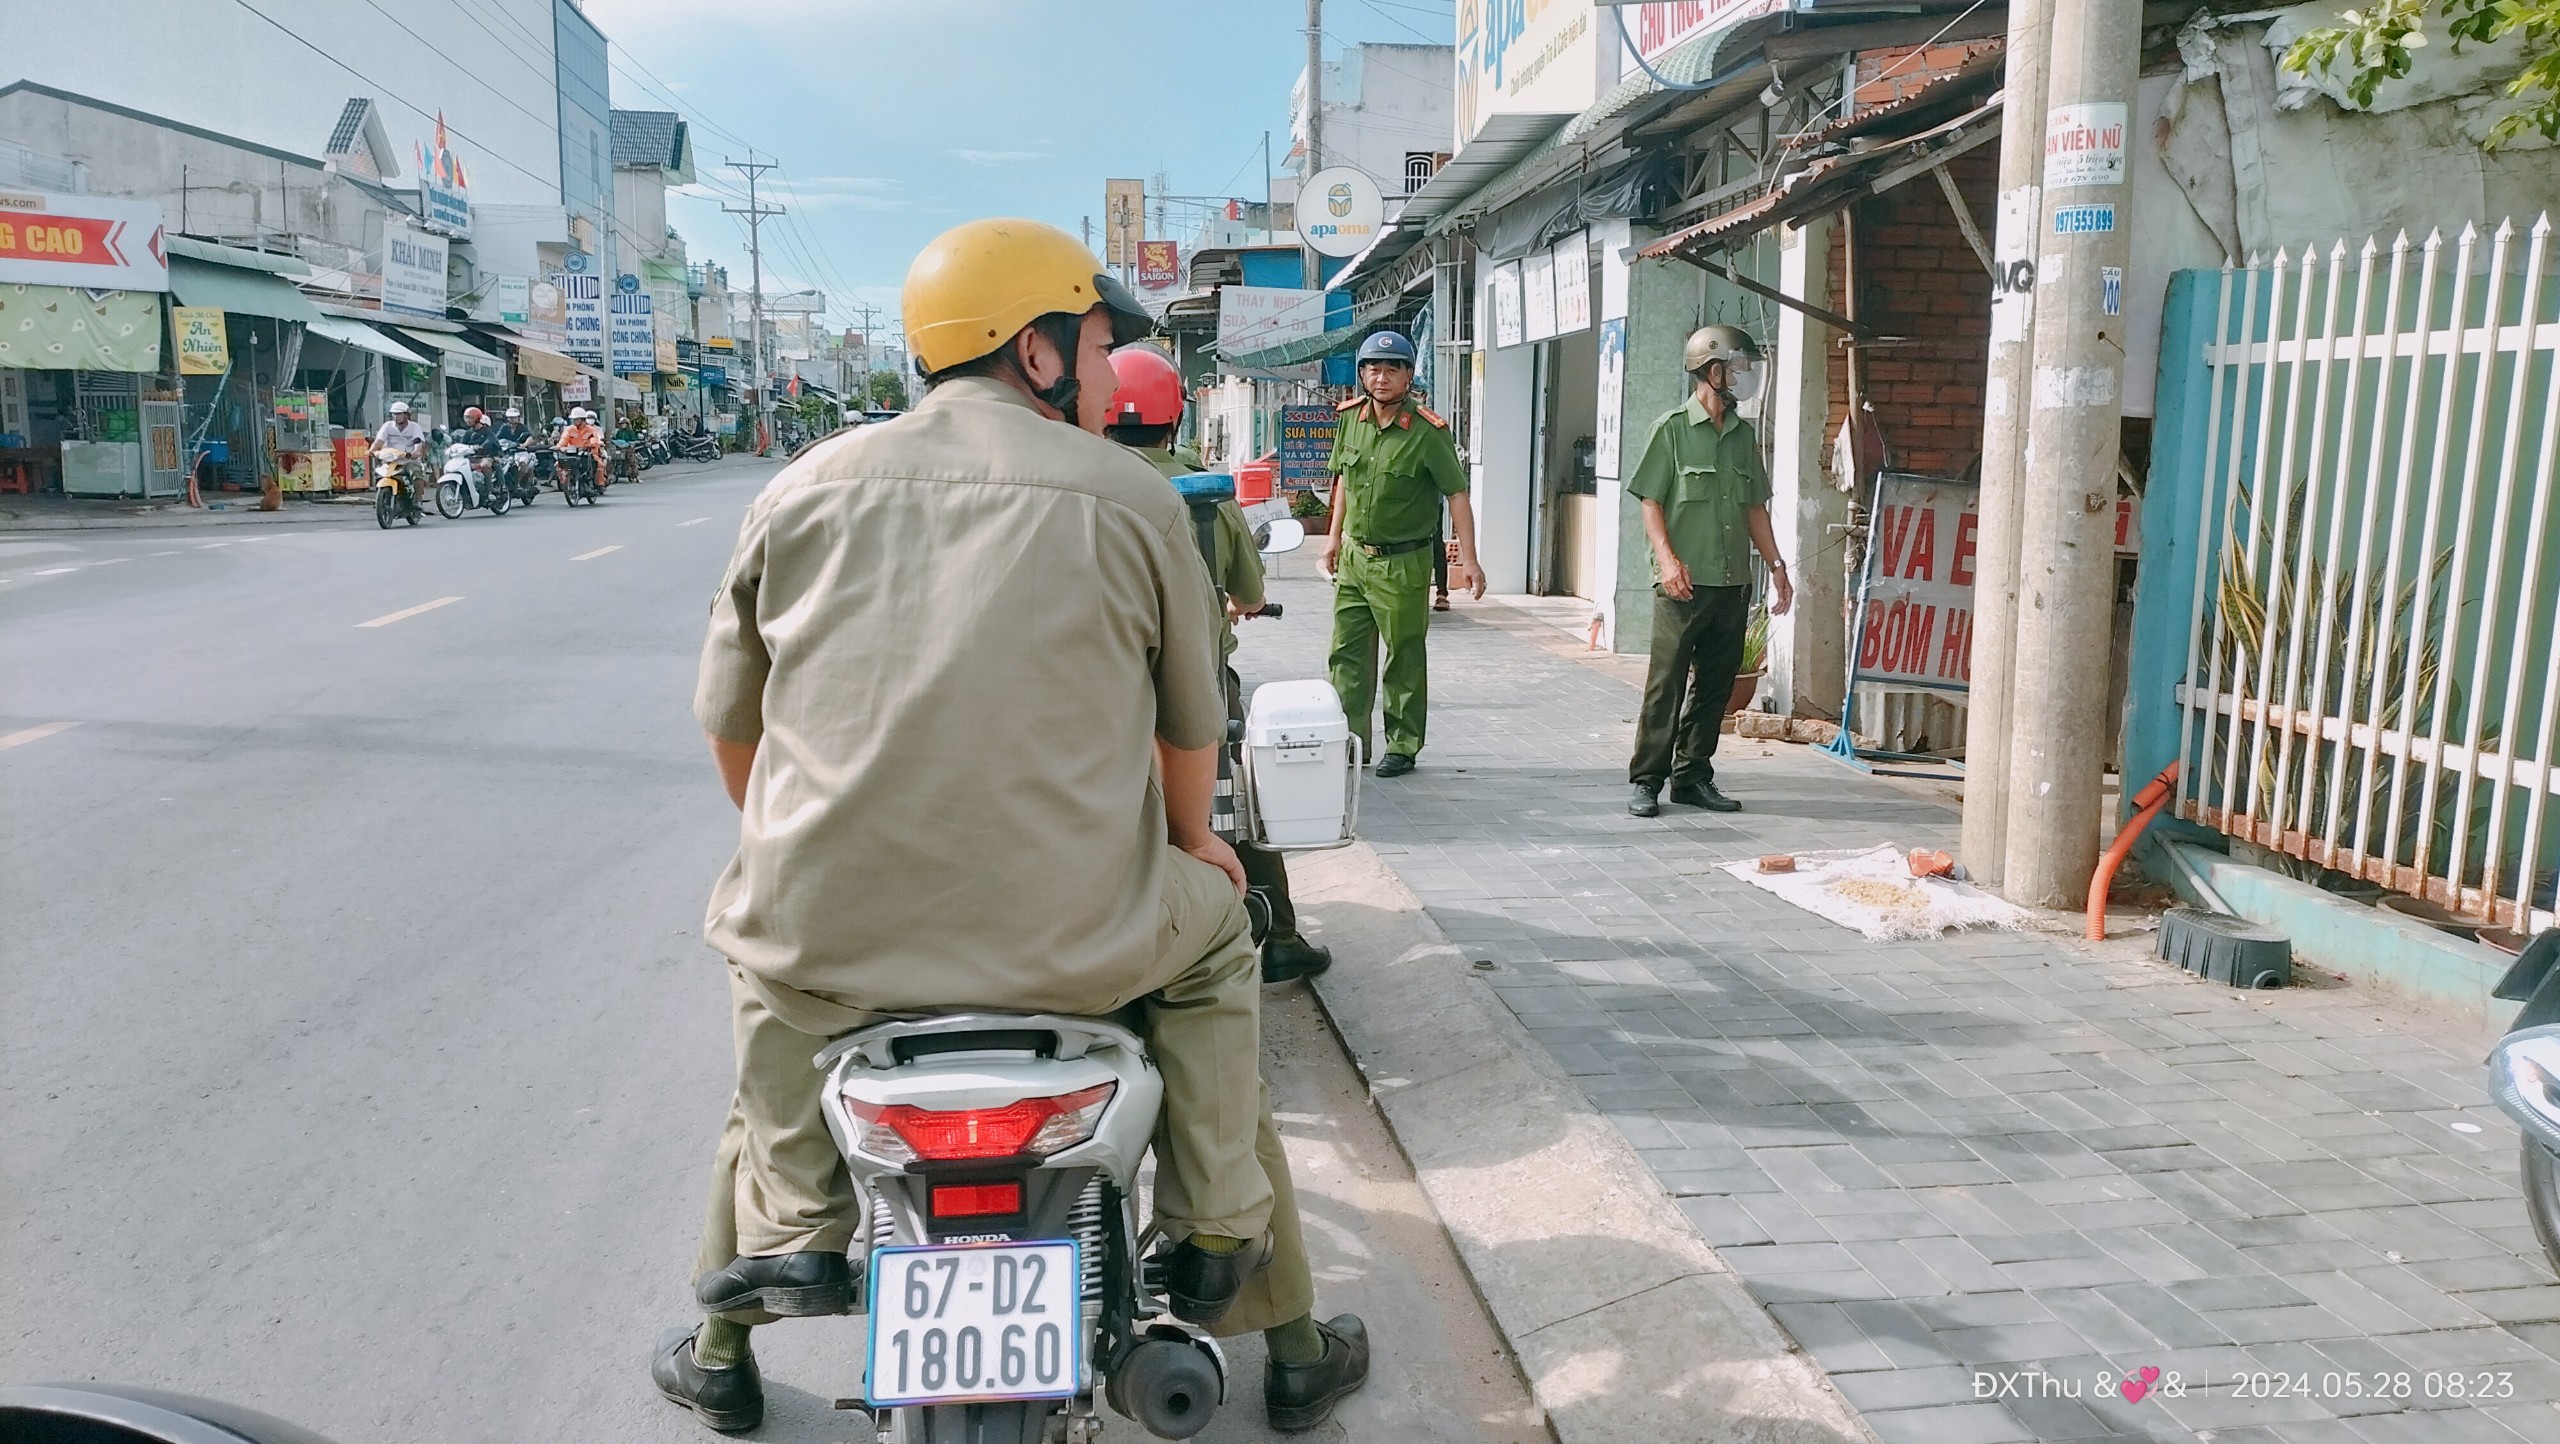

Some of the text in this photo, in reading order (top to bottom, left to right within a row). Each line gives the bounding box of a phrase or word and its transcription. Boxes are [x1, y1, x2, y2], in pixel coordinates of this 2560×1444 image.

[1484, 0, 1549, 91] apa
[2062, 124, 2097, 152] VIÊN
[2101, 123, 2122, 150] NỮ
[1310, 224, 1370, 239] apaoma
[25, 225, 83, 255] CAO
[391, 235, 442, 274] KHẢI MINH
[1141, 272, 1175, 281] SAIGON
[1236, 294, 1265, 308] THAY
[190, 321, 212, 335] An
[575, 315, 600, 331] CHỨNG
[628, 316, 647, 327] PHÒNG
[612, 328, 652, 344] CÔNG CHỨNG
[183, 338, 223, 353] Nhiên
[667, 377, 685, 388] Nails
[1284, 425, 1306, 439] SỬA
[1284, 440, 1295, 449] VÁ
[1296, 441, 1307, 450] ÉP
[1313, 441, 1332, 450] BƠM
[1315, 451, 1331, 459] TAY
[1301, 469, 1330, 478] RỬA XE
[1882, 493, 1936, 582] VÁ
[1859, 591, 1937, 676] BƠM
[943, 1233, 1012, 1245] HONDA
[904, 1254, 1047, 1319] 67-D2
[892, 1322, 1061, 1393] 180.60
